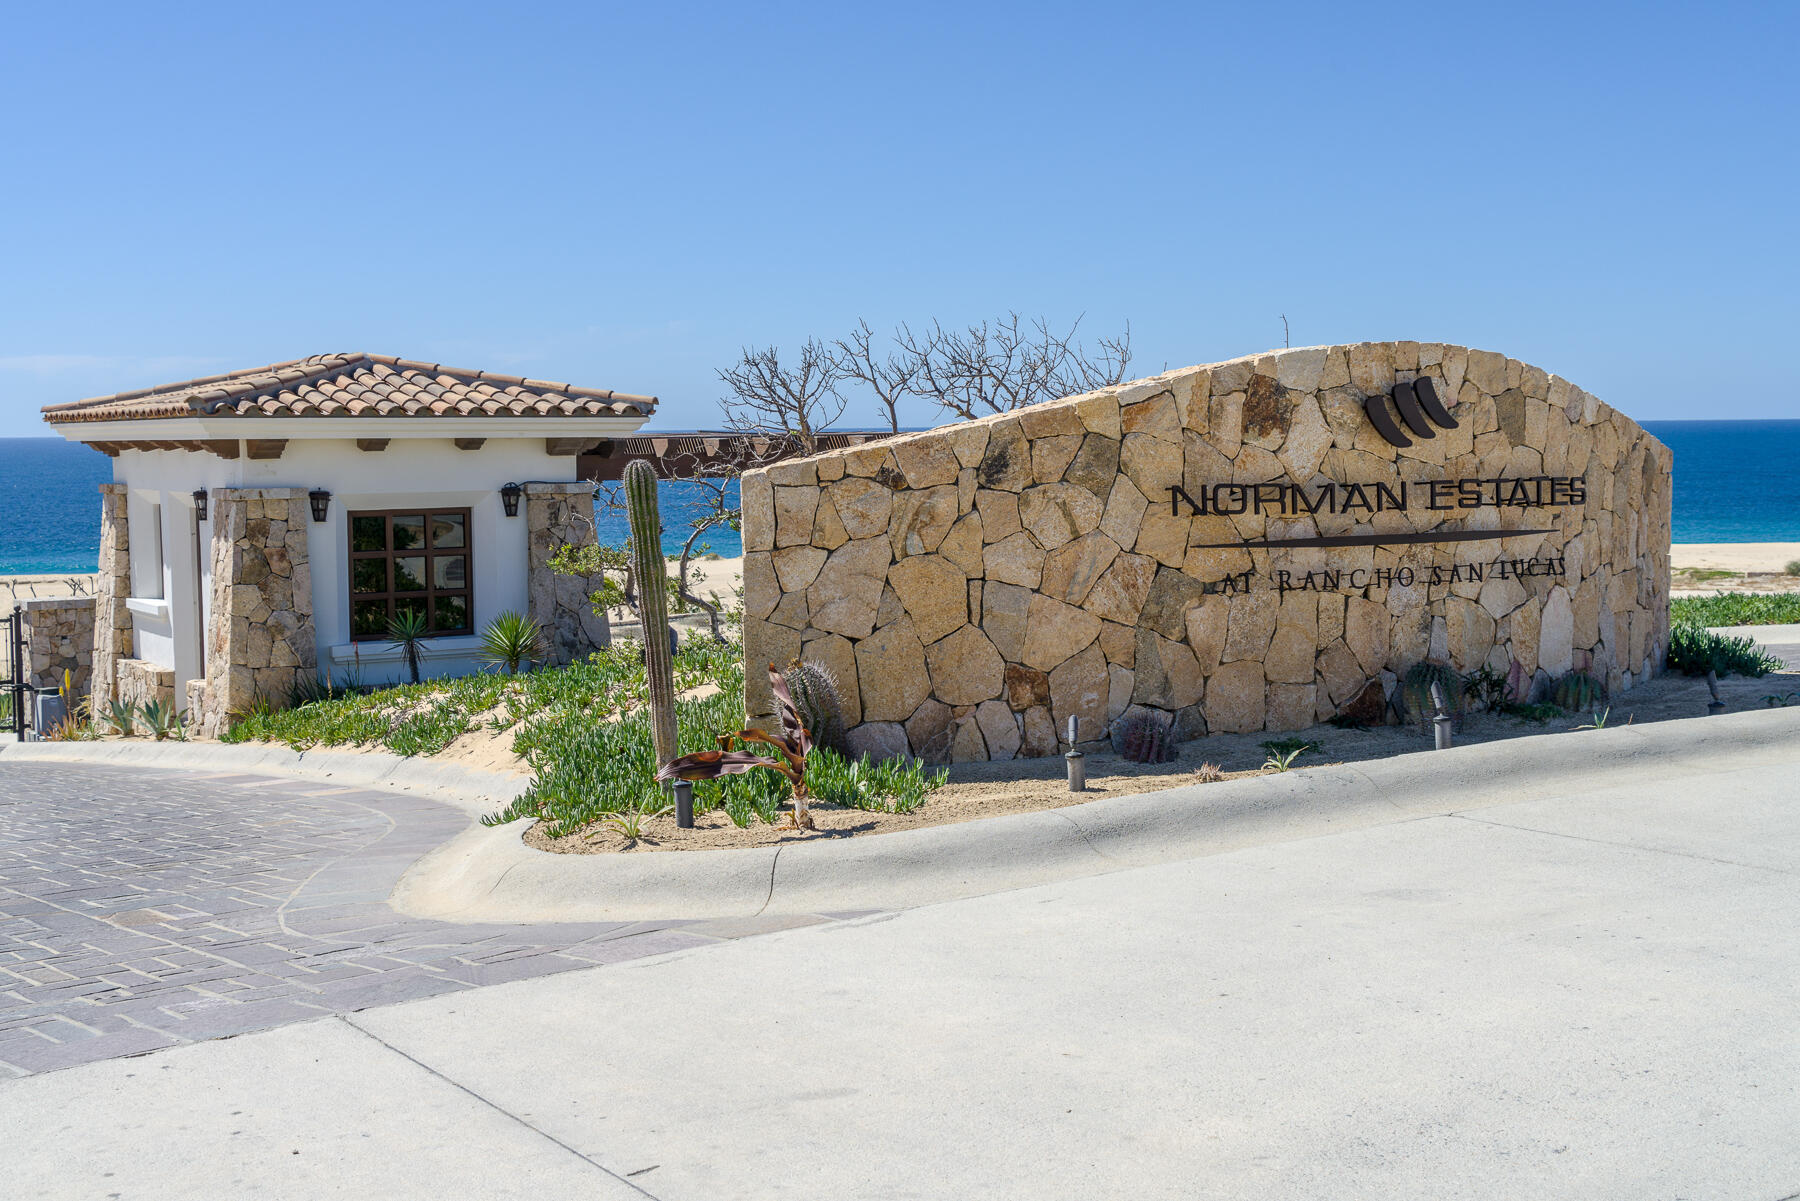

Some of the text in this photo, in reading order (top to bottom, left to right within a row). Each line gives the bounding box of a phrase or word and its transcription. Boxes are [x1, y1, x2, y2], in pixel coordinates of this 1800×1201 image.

[1172, 476, 1587, 516] NORMAN ESTATES
[1221, 556, 1566, 594] AT RANCHO SAN LUCAS
